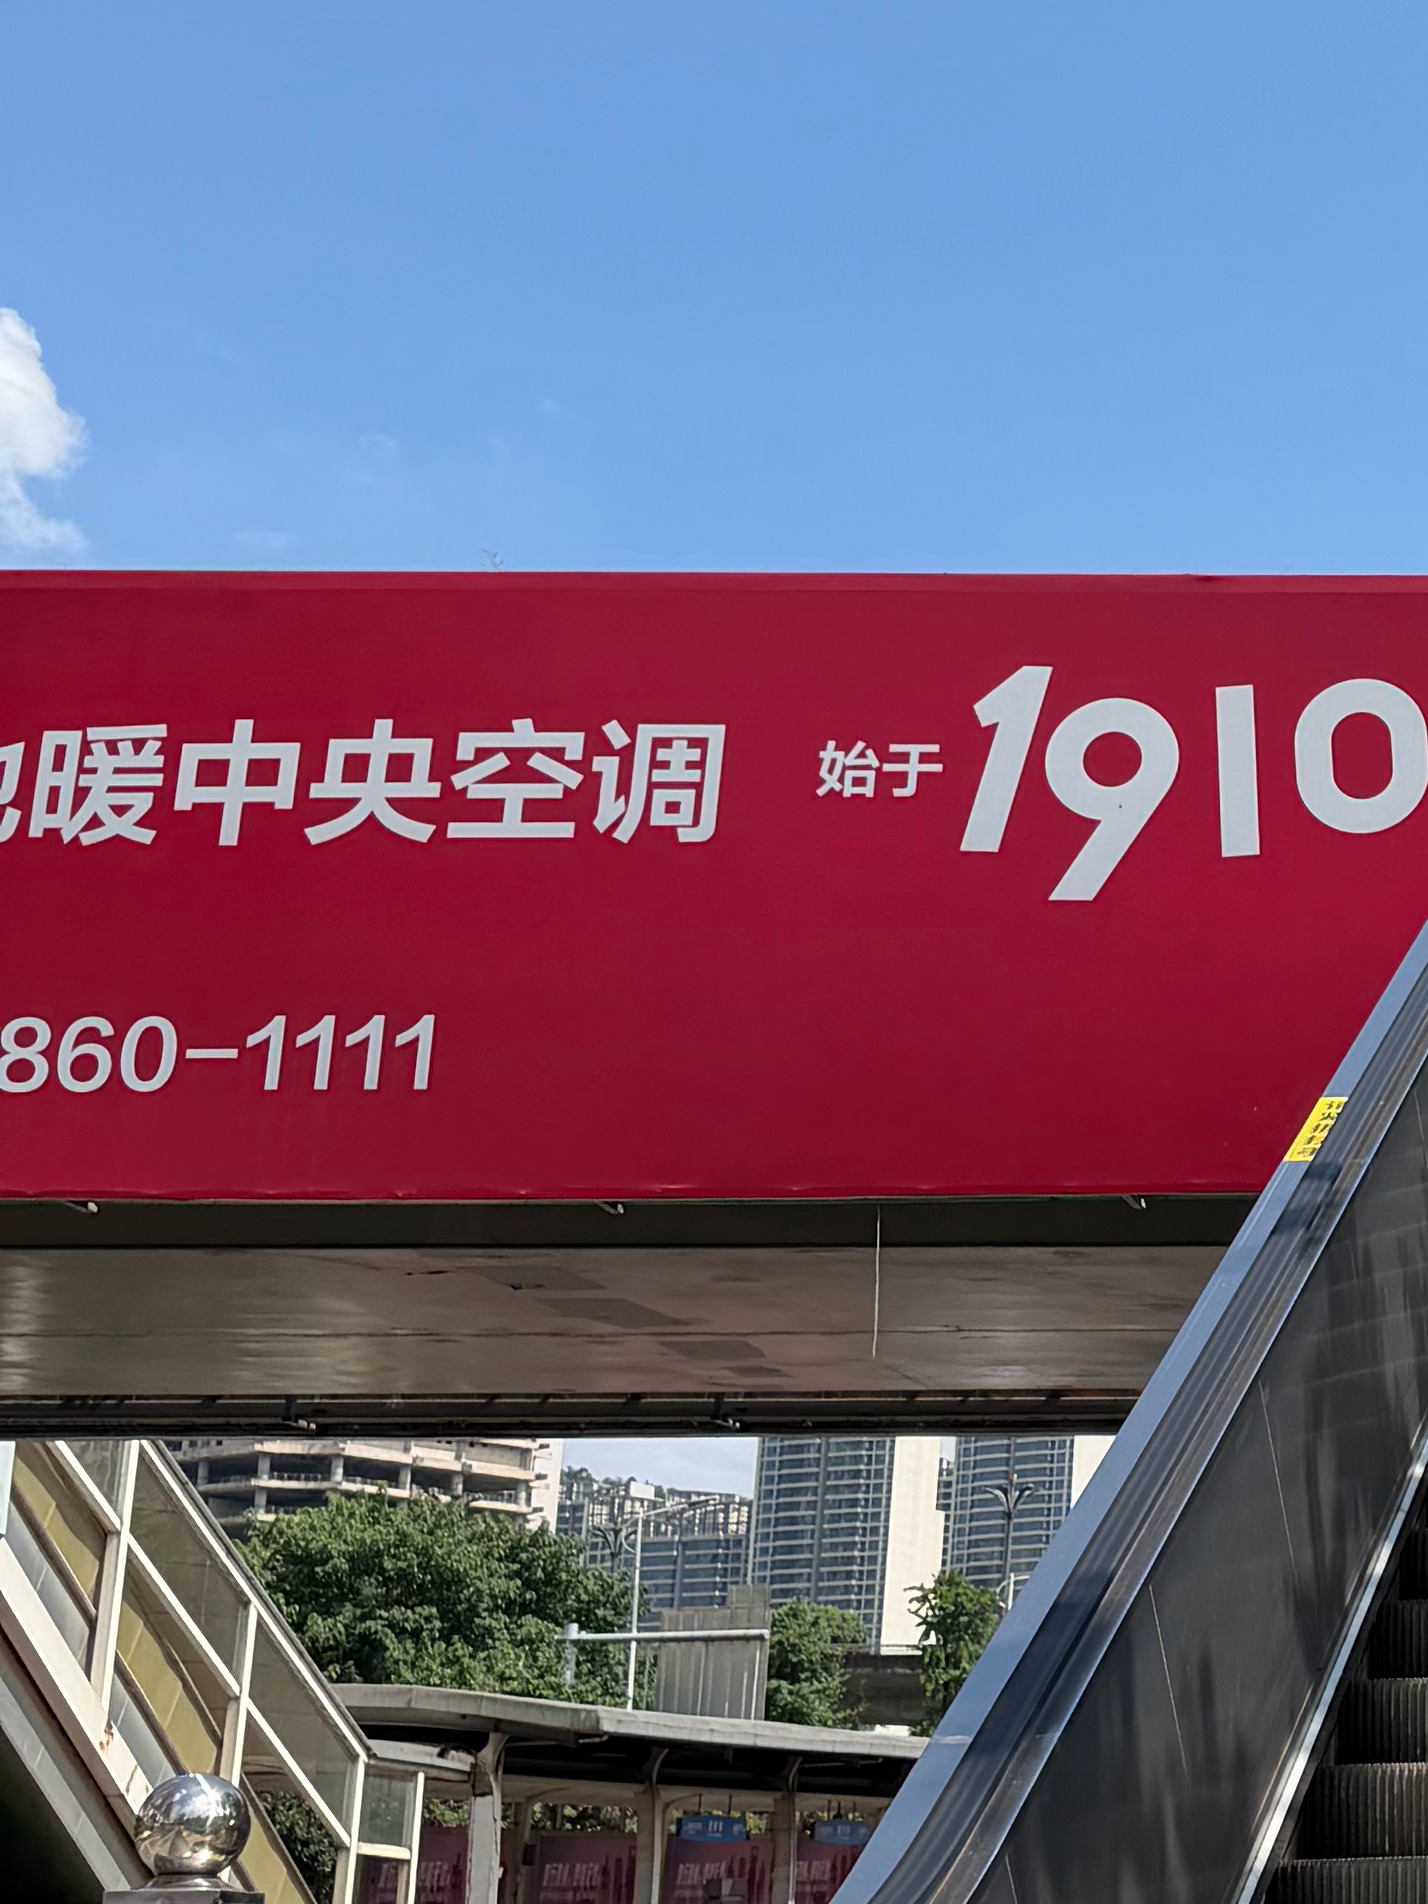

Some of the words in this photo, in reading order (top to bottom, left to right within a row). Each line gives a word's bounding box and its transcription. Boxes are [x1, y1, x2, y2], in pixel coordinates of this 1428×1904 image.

[0, 718, 726, 847] 暖中央空调
[816, 740, 943, 799] 始于
[0, 1014, 436, 1093] 860-1111
